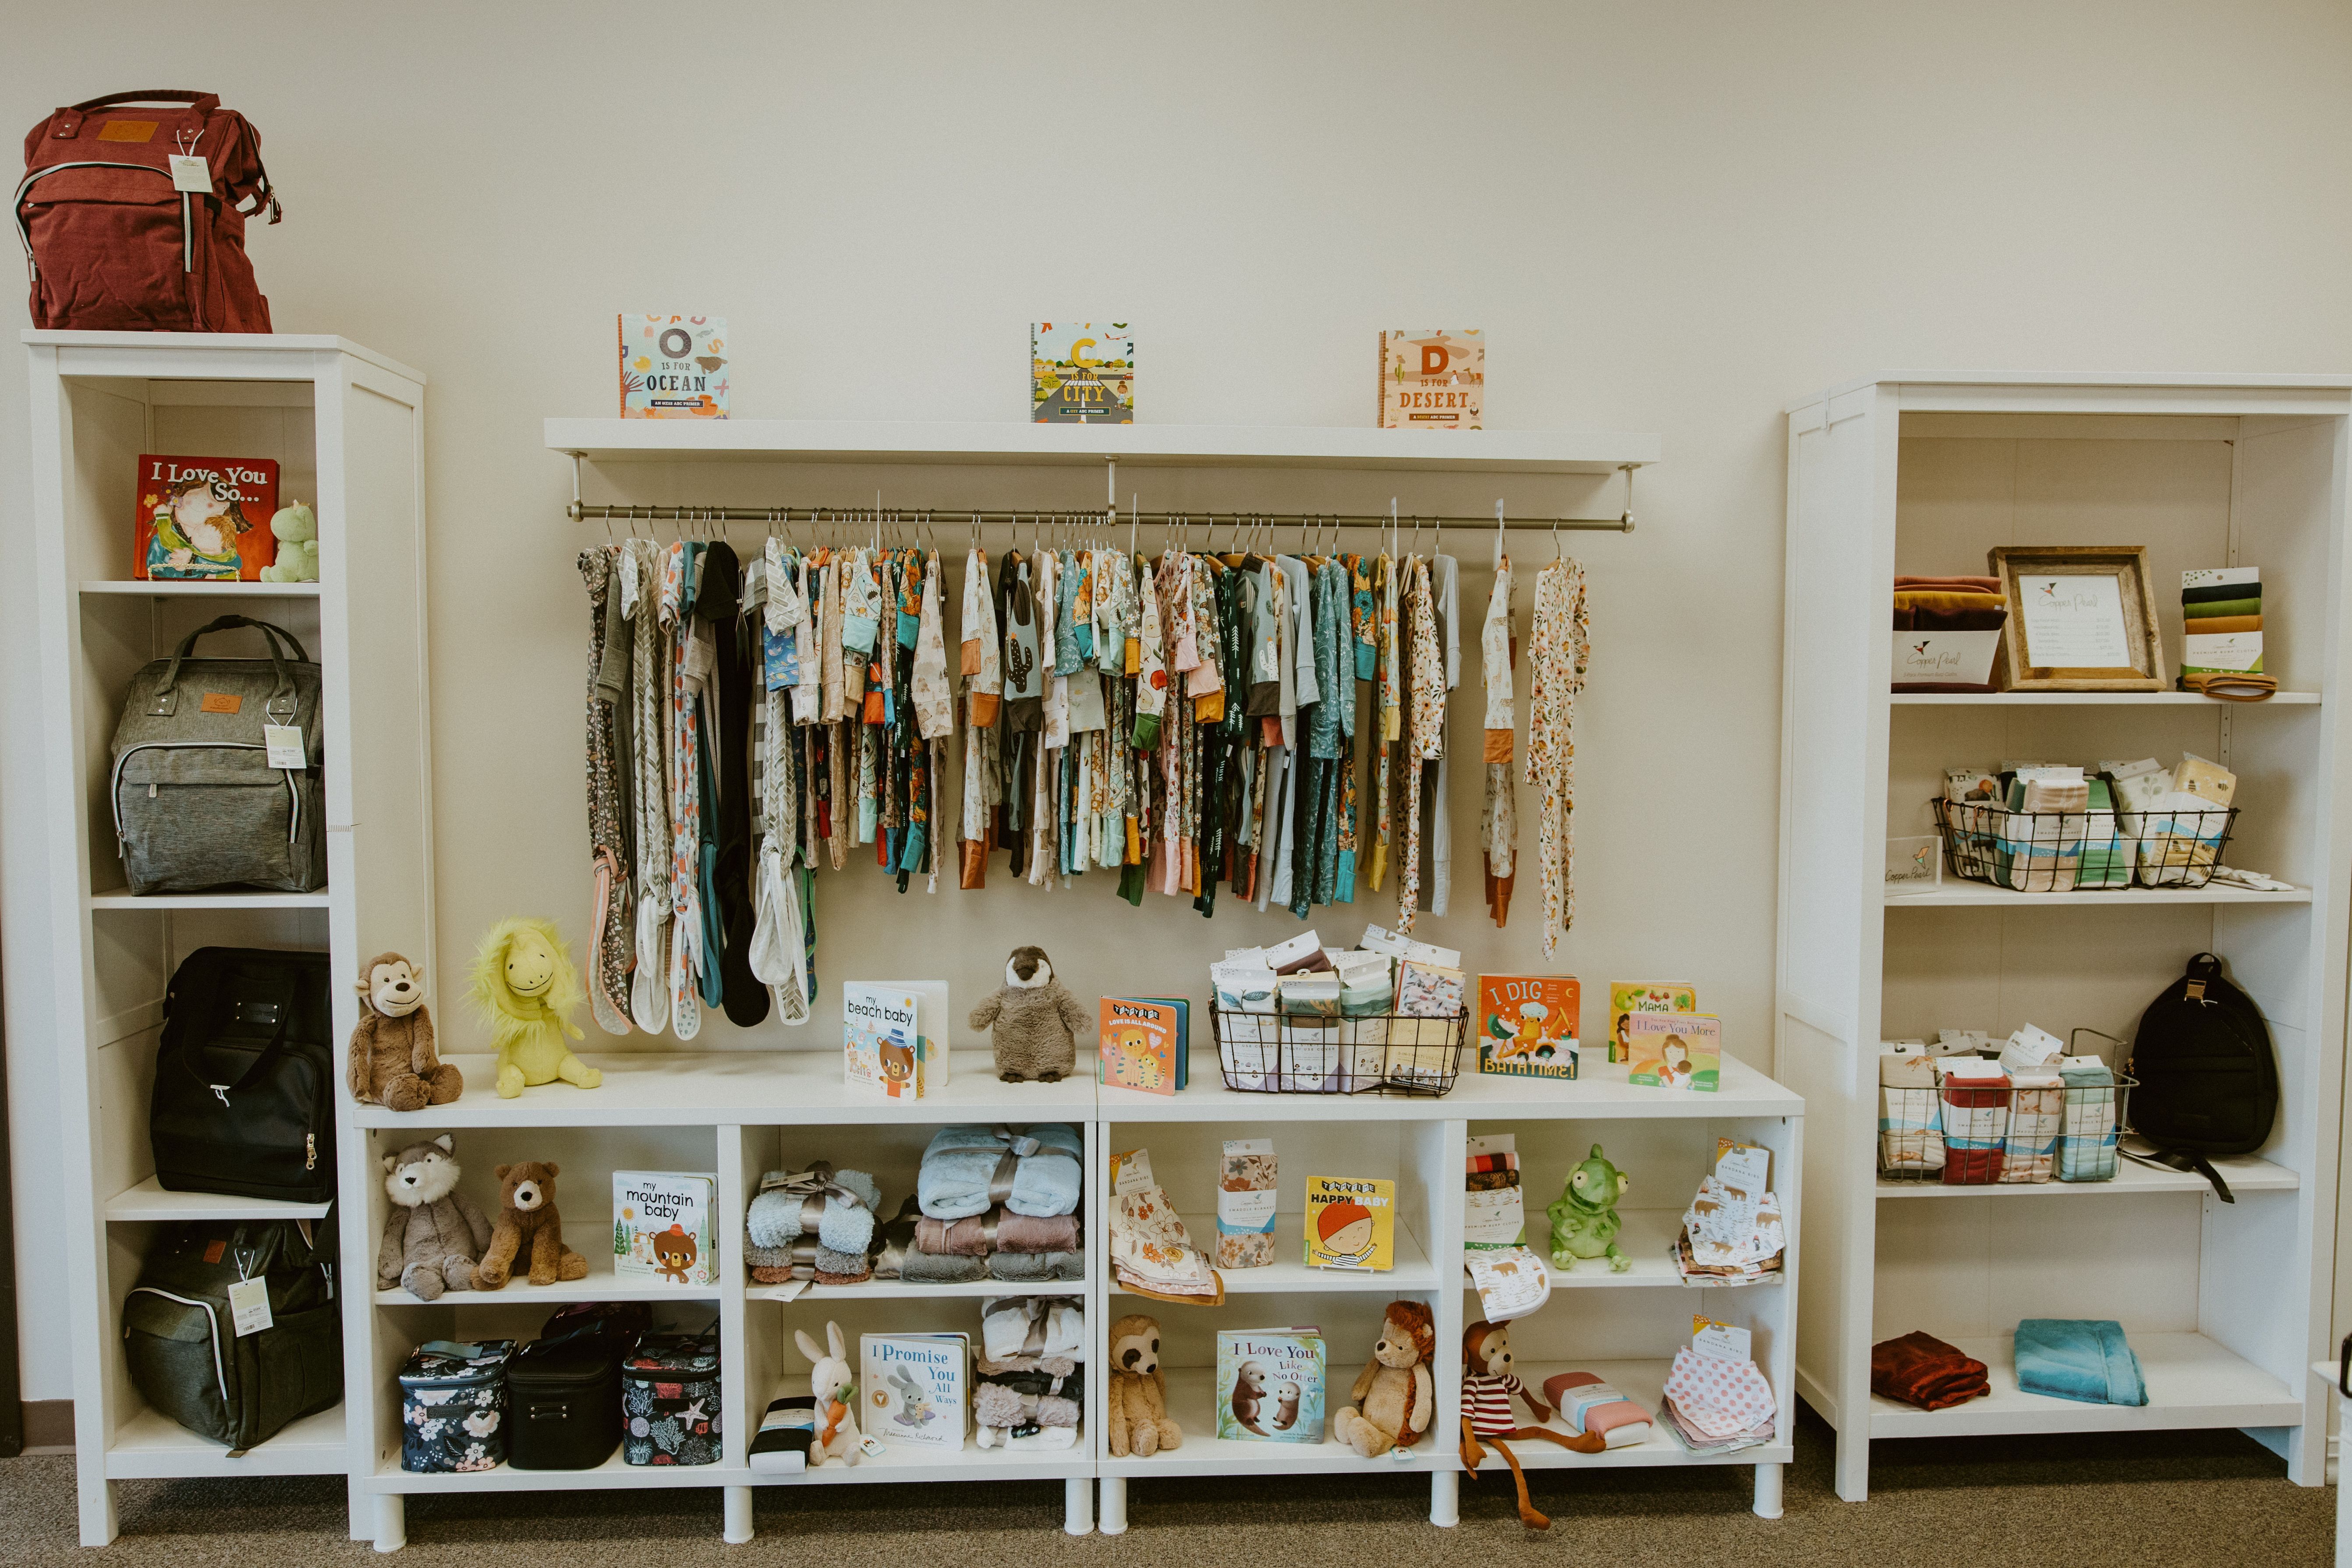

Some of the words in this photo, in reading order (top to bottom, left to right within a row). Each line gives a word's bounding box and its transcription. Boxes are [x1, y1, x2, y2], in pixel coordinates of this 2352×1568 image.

[659, 329, 692, 358] O
[1071, 338, 1097, 368] C
[1421, 346, 1449, 375] D
[674, 362, 691, 371] FOR
[647, 375, 706, 391] OCEAN
[1064, 386, 1105, 402] CITY
[1399, 393, 1469, 407] DESERT
[151, 462, 162, 480] I
[168, 464, 219, 482] Love
[225, 467, 268, 486] You
[215, 483, 259, 502] So...
[2039, 595, 2071, 610] Copper
[2074, 594, 2098, 611] Pearl
[1907, 652, 1936, 669] Copper
[1937, 651, 1961, 669] Pearl
[1885, 870, 1910, 884] Copper
[1911, 866, 1931, 879] Pearl
[866, 997, 876, 1005] my
[1490, 988, 1502, 1005] I
[1506, 981, 1542, 1001] DIG
[848, 1000, 881, 1019] beach
[885, 1007, 913, 1026] baby
[1639, 1001, 1668, 1012] MAMA
[1142, 1022, 1167, 1034] AROUND
[1637, 1020, 1640, 1029] I
[1644, 1021, 1666, 1032] Love
[1669, 1023, 1687, 1034] You
[1691, 1025, 1715, 1036] More
[1484, 1058, 1574, 1079] BATHTIME!
[1721, 1165, 1745, 1174] BANDANA
[643, 1182, 656, 1191] my
[627, 1191, 693, 1207] mountain
[1311, 1194, 1353, 1204] HAPPY
[1355, 1196, 1389, 1207] BABY
[645, 1203, 679, 1221] baby
[1234, 1343, 1239, 1355] I
[1247, 1342, 1282, 1357] Love
[1287, 1346, 1314, 1359] You
[1700, 1338, 1726, 1349] BANDANA
[873, 1345, 877, 1357] I
[882, 1344, 948, 1364] Promise
[1279, 1360, 1302, 1370] Like
[928, 1366, 955, 1381] You
[1273, 1372, 1287, 1381] No
[1290, 1372, 1318, 1383] Otter
[929, 1383, 950, 1394] All
[935, 1395, 956, 1406] Ways
[878, 1427, 913, 1438] Marianne
[915, 1433, 947, 1442] Richmond
